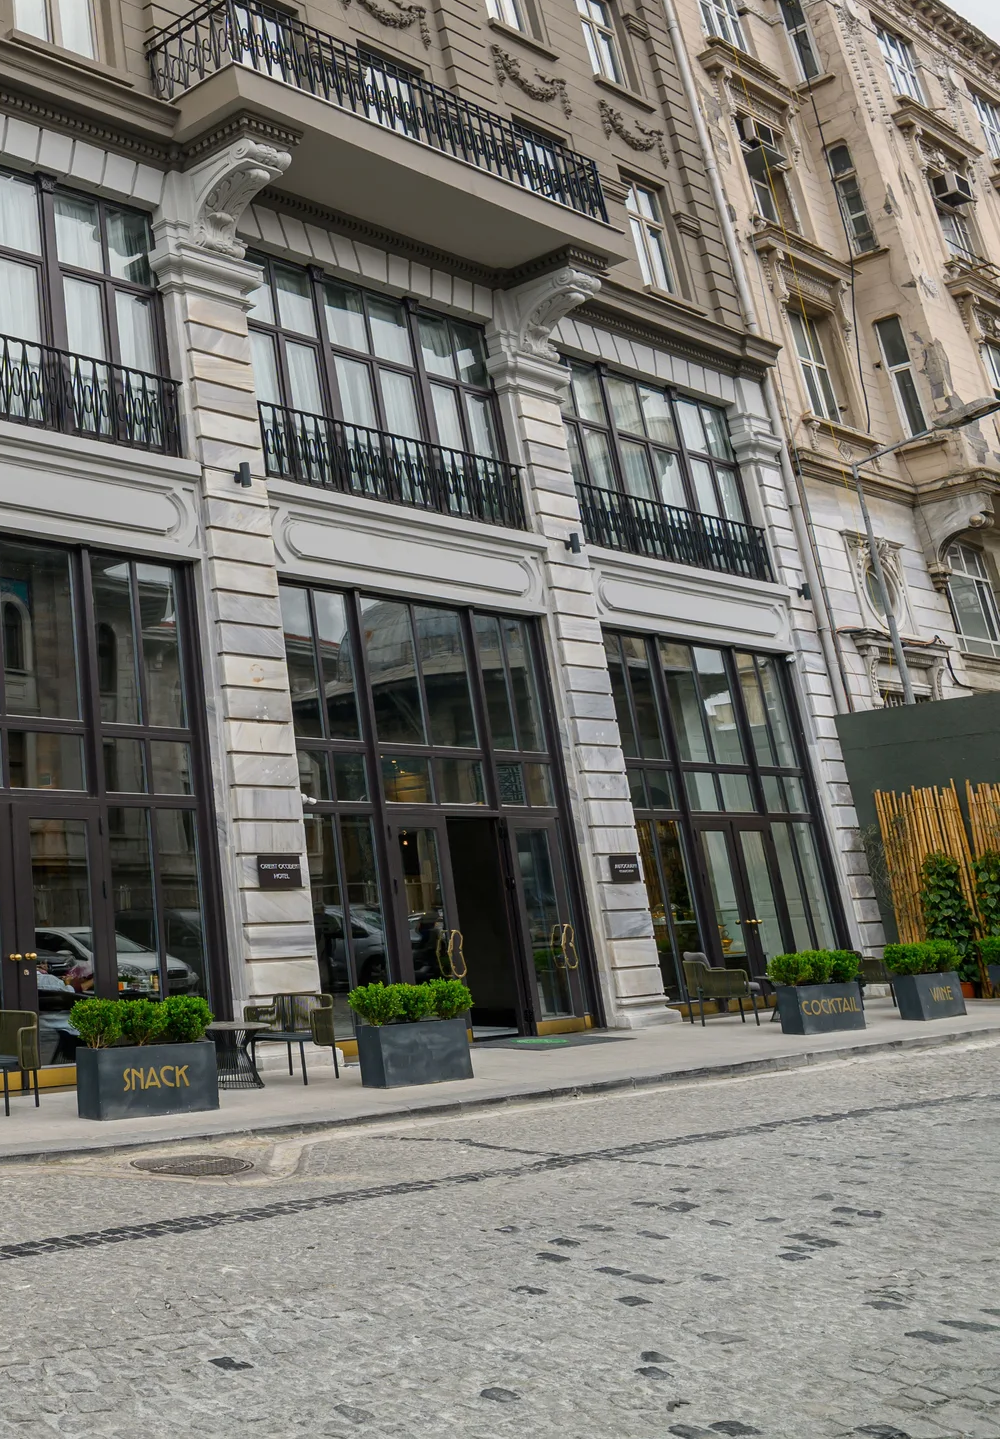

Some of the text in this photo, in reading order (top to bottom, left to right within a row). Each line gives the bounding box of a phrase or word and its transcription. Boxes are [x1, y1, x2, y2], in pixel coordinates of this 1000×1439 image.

[929, 986, 954, 1002] WINE
[801, 997, 861, 1016] COCKTAIL
[123, 1065, 190, 1091] SNACK
